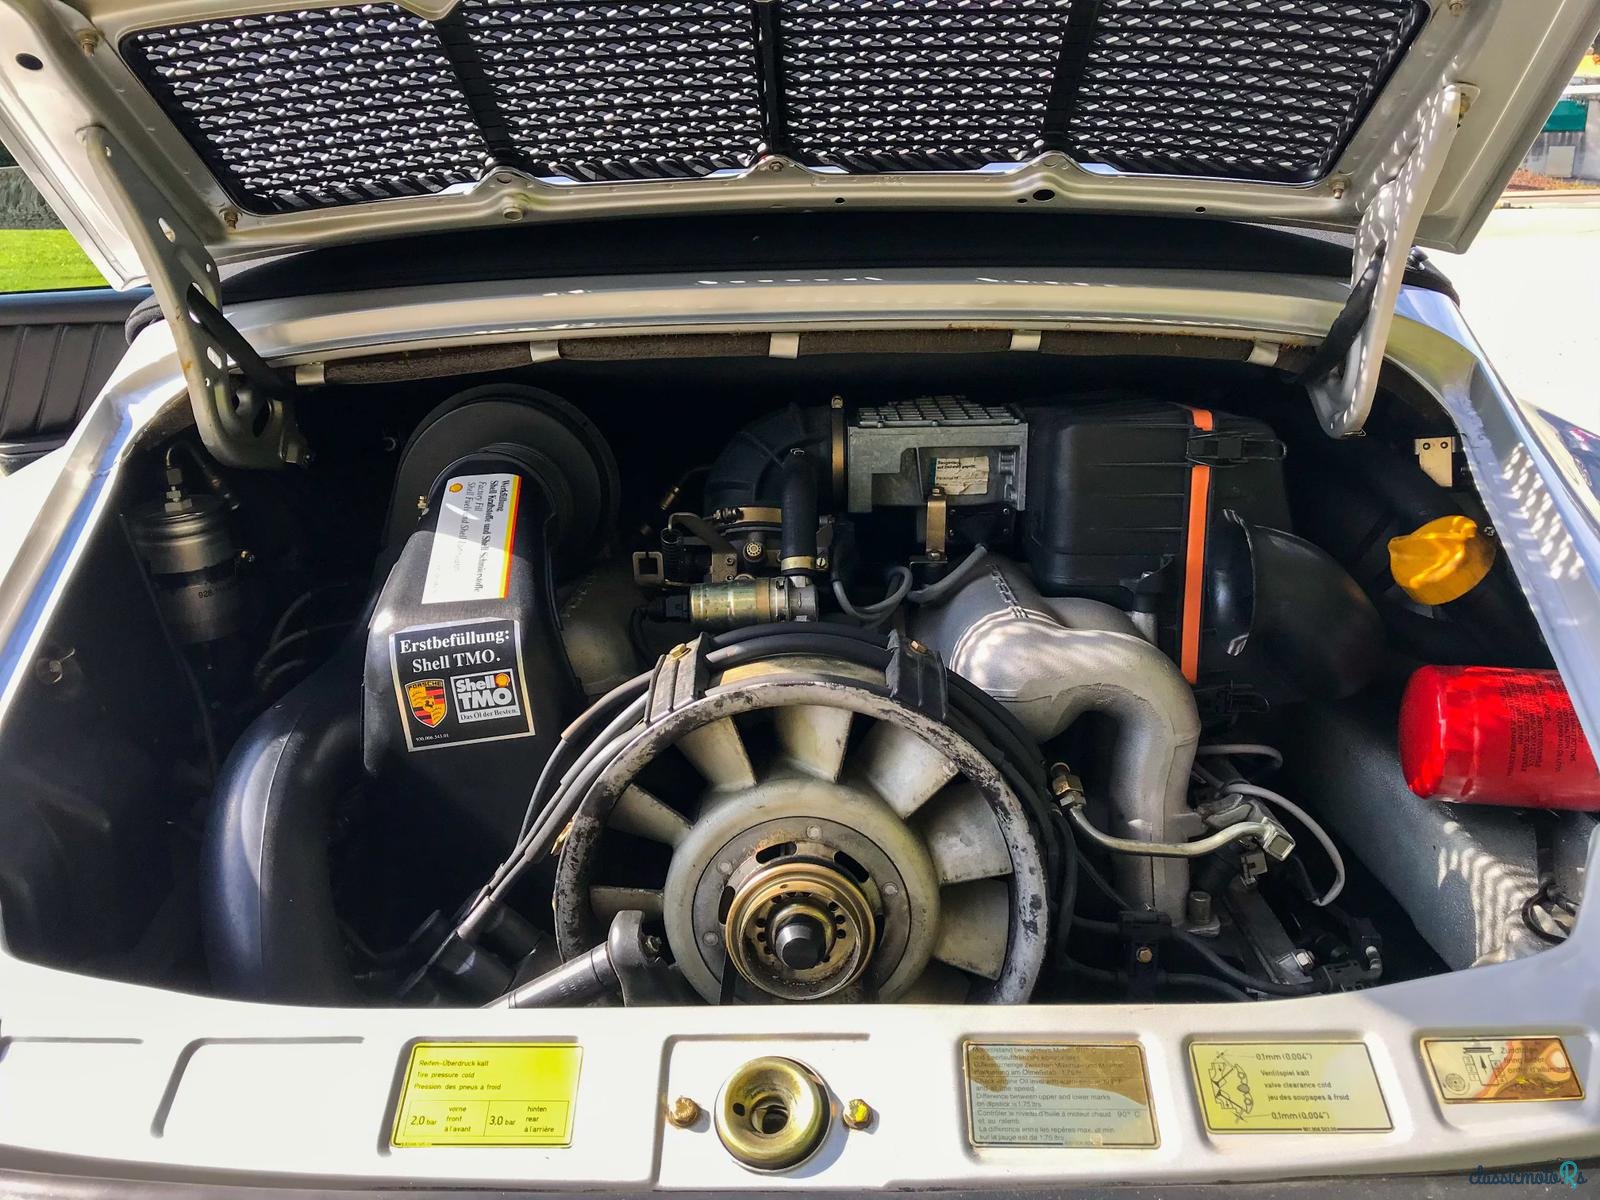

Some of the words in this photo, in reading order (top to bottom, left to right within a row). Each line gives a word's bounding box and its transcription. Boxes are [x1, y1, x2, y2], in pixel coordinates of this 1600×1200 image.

[466, 482, 476, 496] Shell
[489, 480, 499, 494] Shell
[474, 502, 484, 512] Fill
[482, 523, 491, 535] und
[400, 629, 510, 654] Erstbefüllung:
[412, 655, 450, 673] Shell
[453, 648, 501, 667] TMO.
[455, 674, 496, 693] Shell
[457, 687, 513, 710] TMO
[460, 712, 473, 721] Das
[482, 709, 493, 719] der
[493, 707, 519, 717] Besten.
[431, 1072, 459, 1080] pressure
[1260, 1069, 1295, 1077] Ventilspiel
[414, 1083, 442, 1091] Pression
[458, 1084, 479, 1092] pneus
[1268, 1094, 1280, 1102] jeu
[1293, 1094, 1326, 1102] soupapes
[1333, 1093, 1350, 1101] froid
